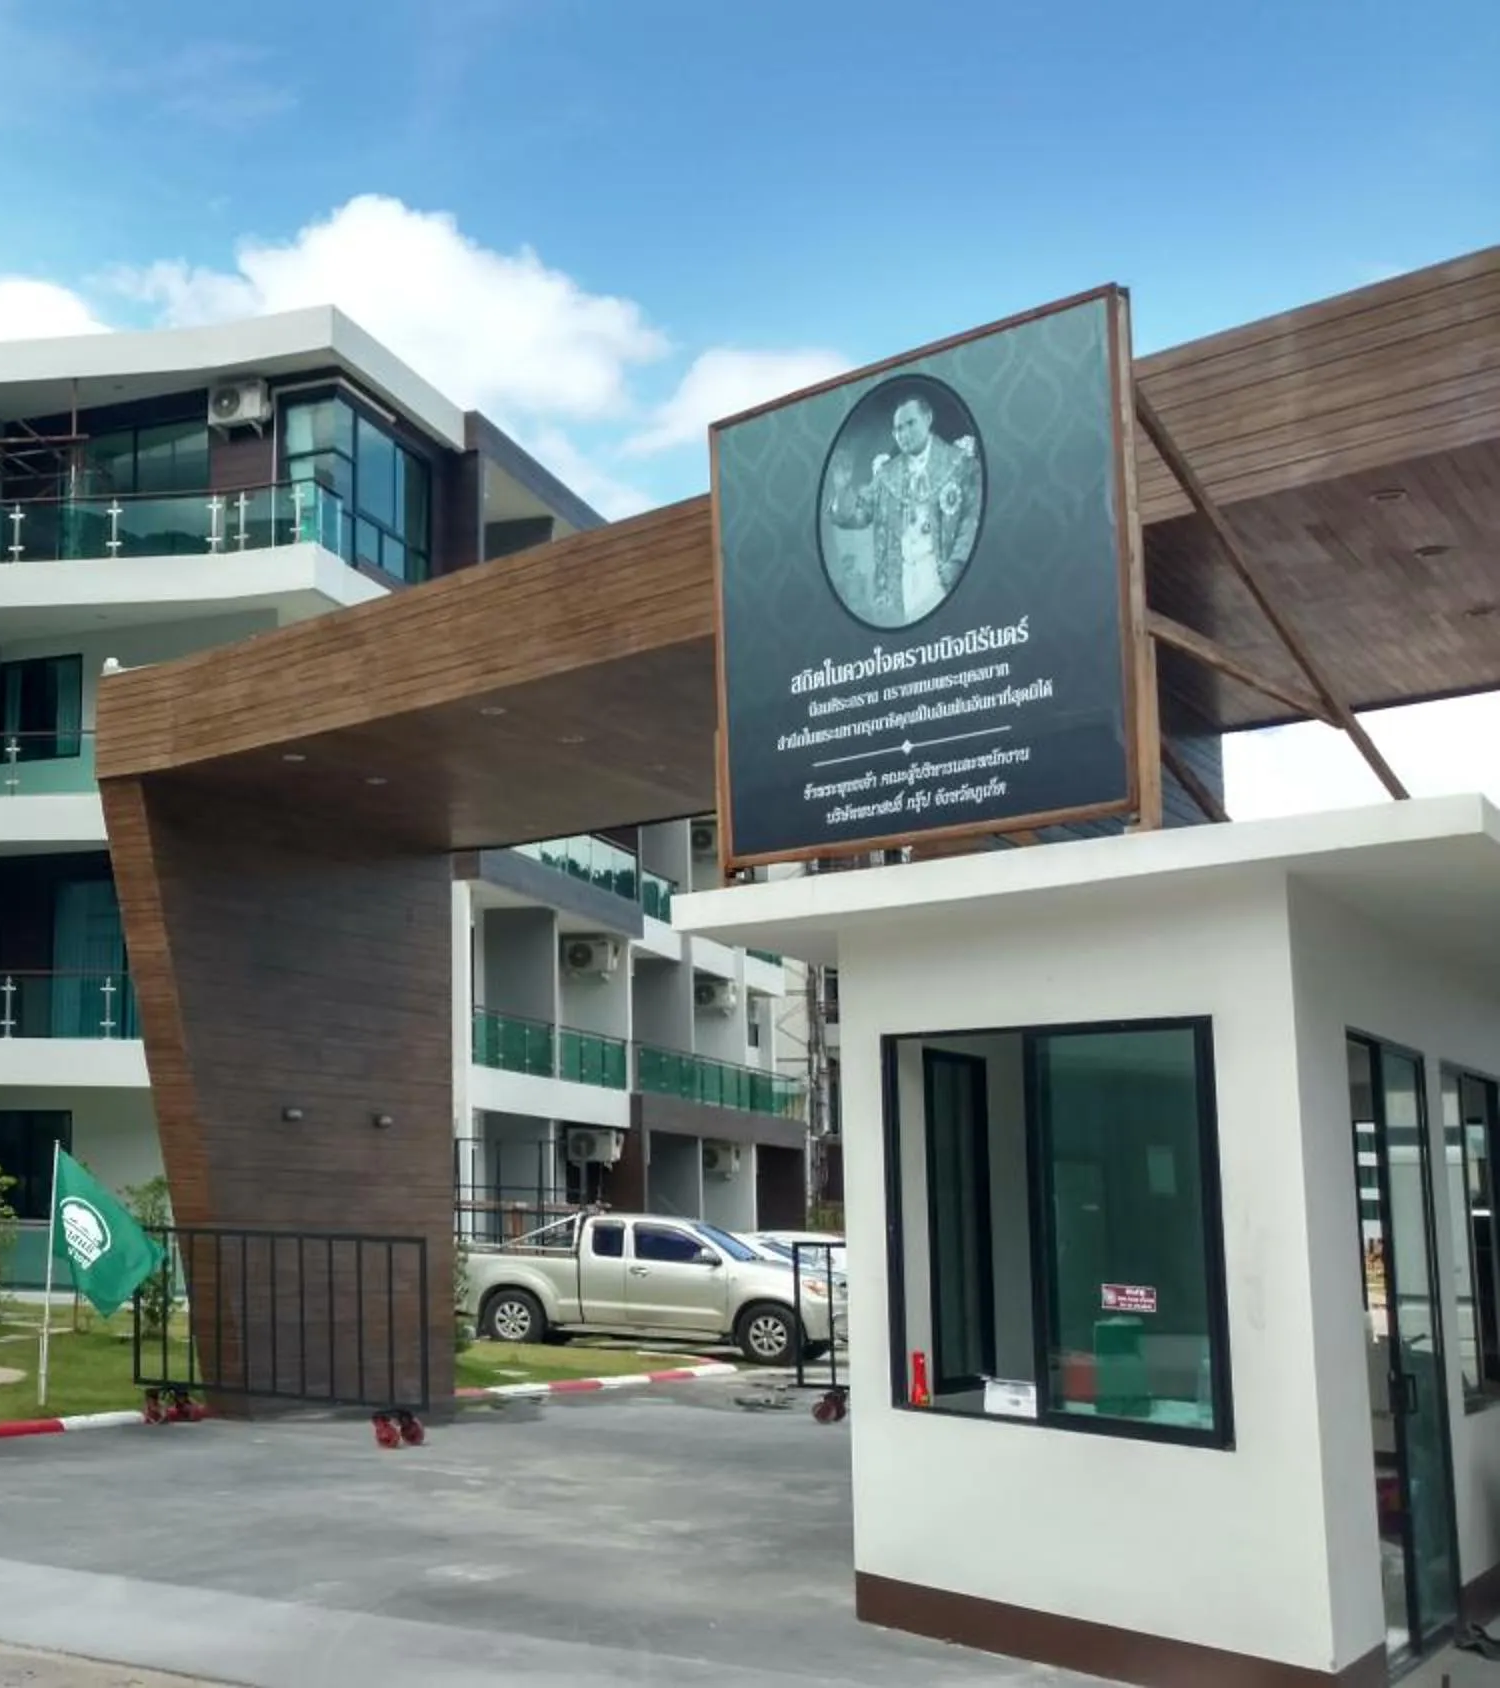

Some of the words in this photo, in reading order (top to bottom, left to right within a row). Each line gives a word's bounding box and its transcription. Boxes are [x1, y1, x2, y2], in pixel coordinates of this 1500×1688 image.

[791, 616, 1029, 695] สถิตในดวงใจตราบนิจนิรันดร์
